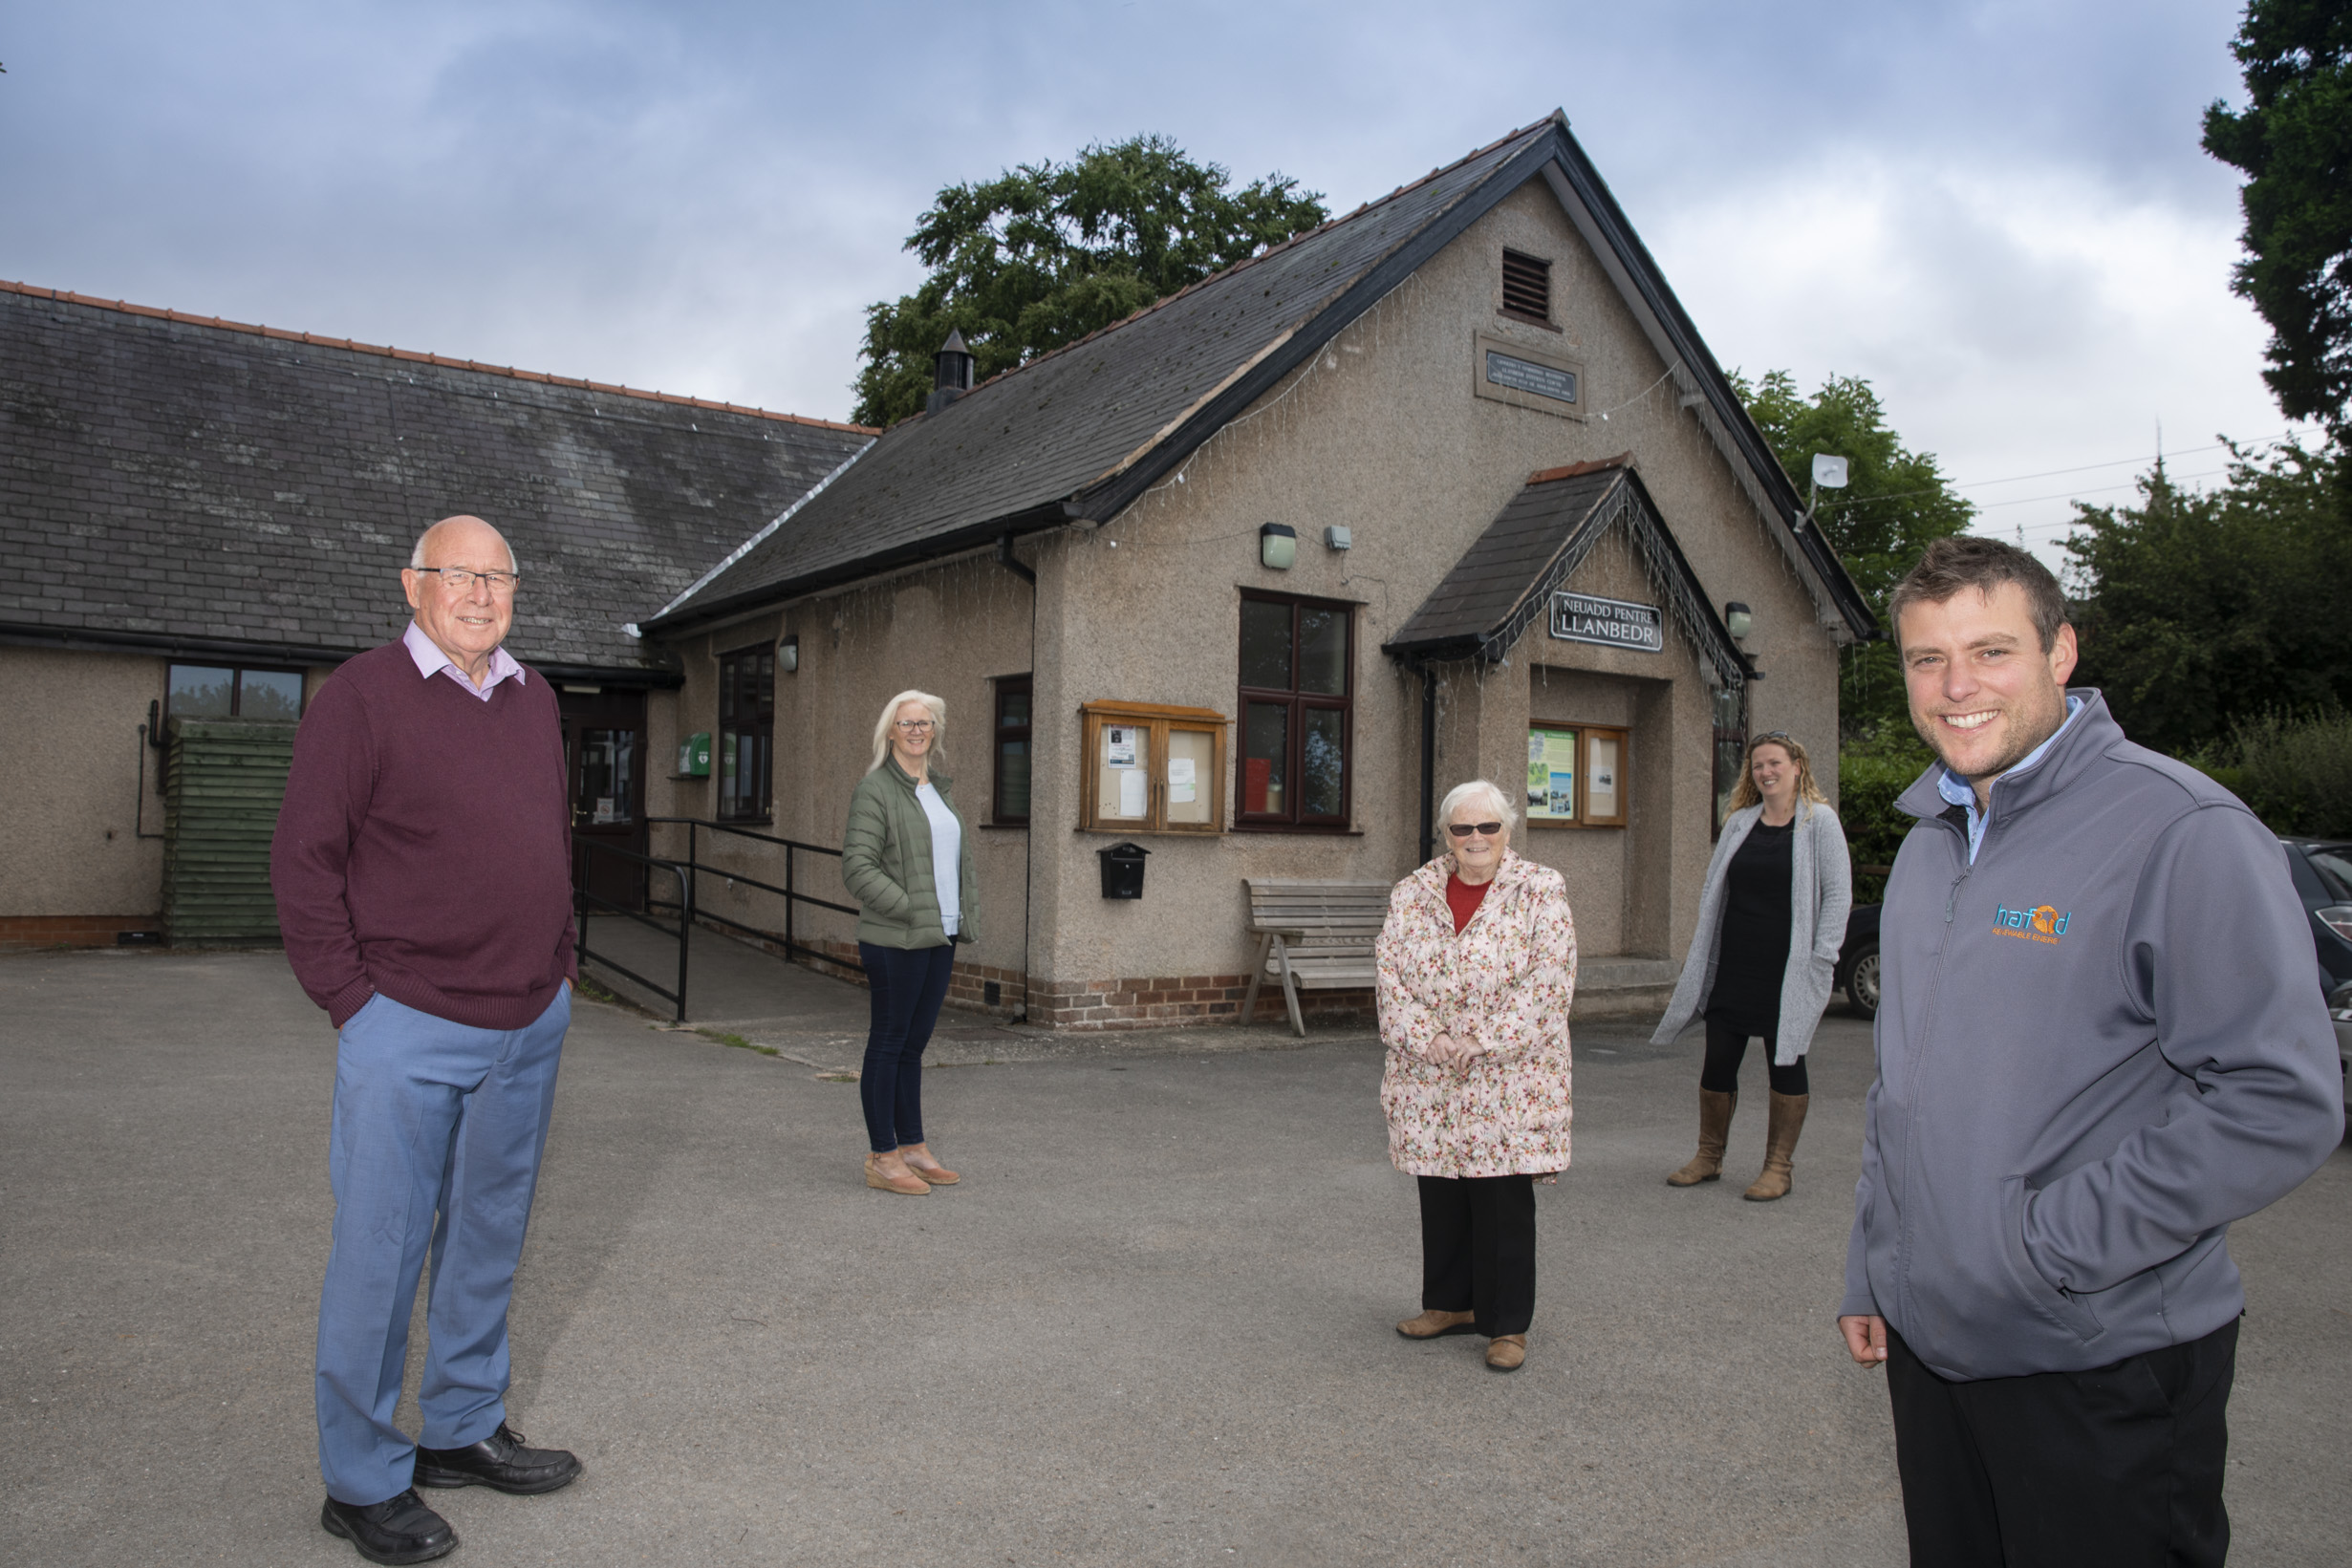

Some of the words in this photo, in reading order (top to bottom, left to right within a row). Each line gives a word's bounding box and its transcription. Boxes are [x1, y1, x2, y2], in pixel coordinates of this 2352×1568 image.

[1564, 599, 1611, 617] NEUADD
[1614, 607, 1652, 624] PENTRE
[1562, 613, 1653, 643] LLANBEDR
[1992, 928, 2032, 940] RENEWABLE
